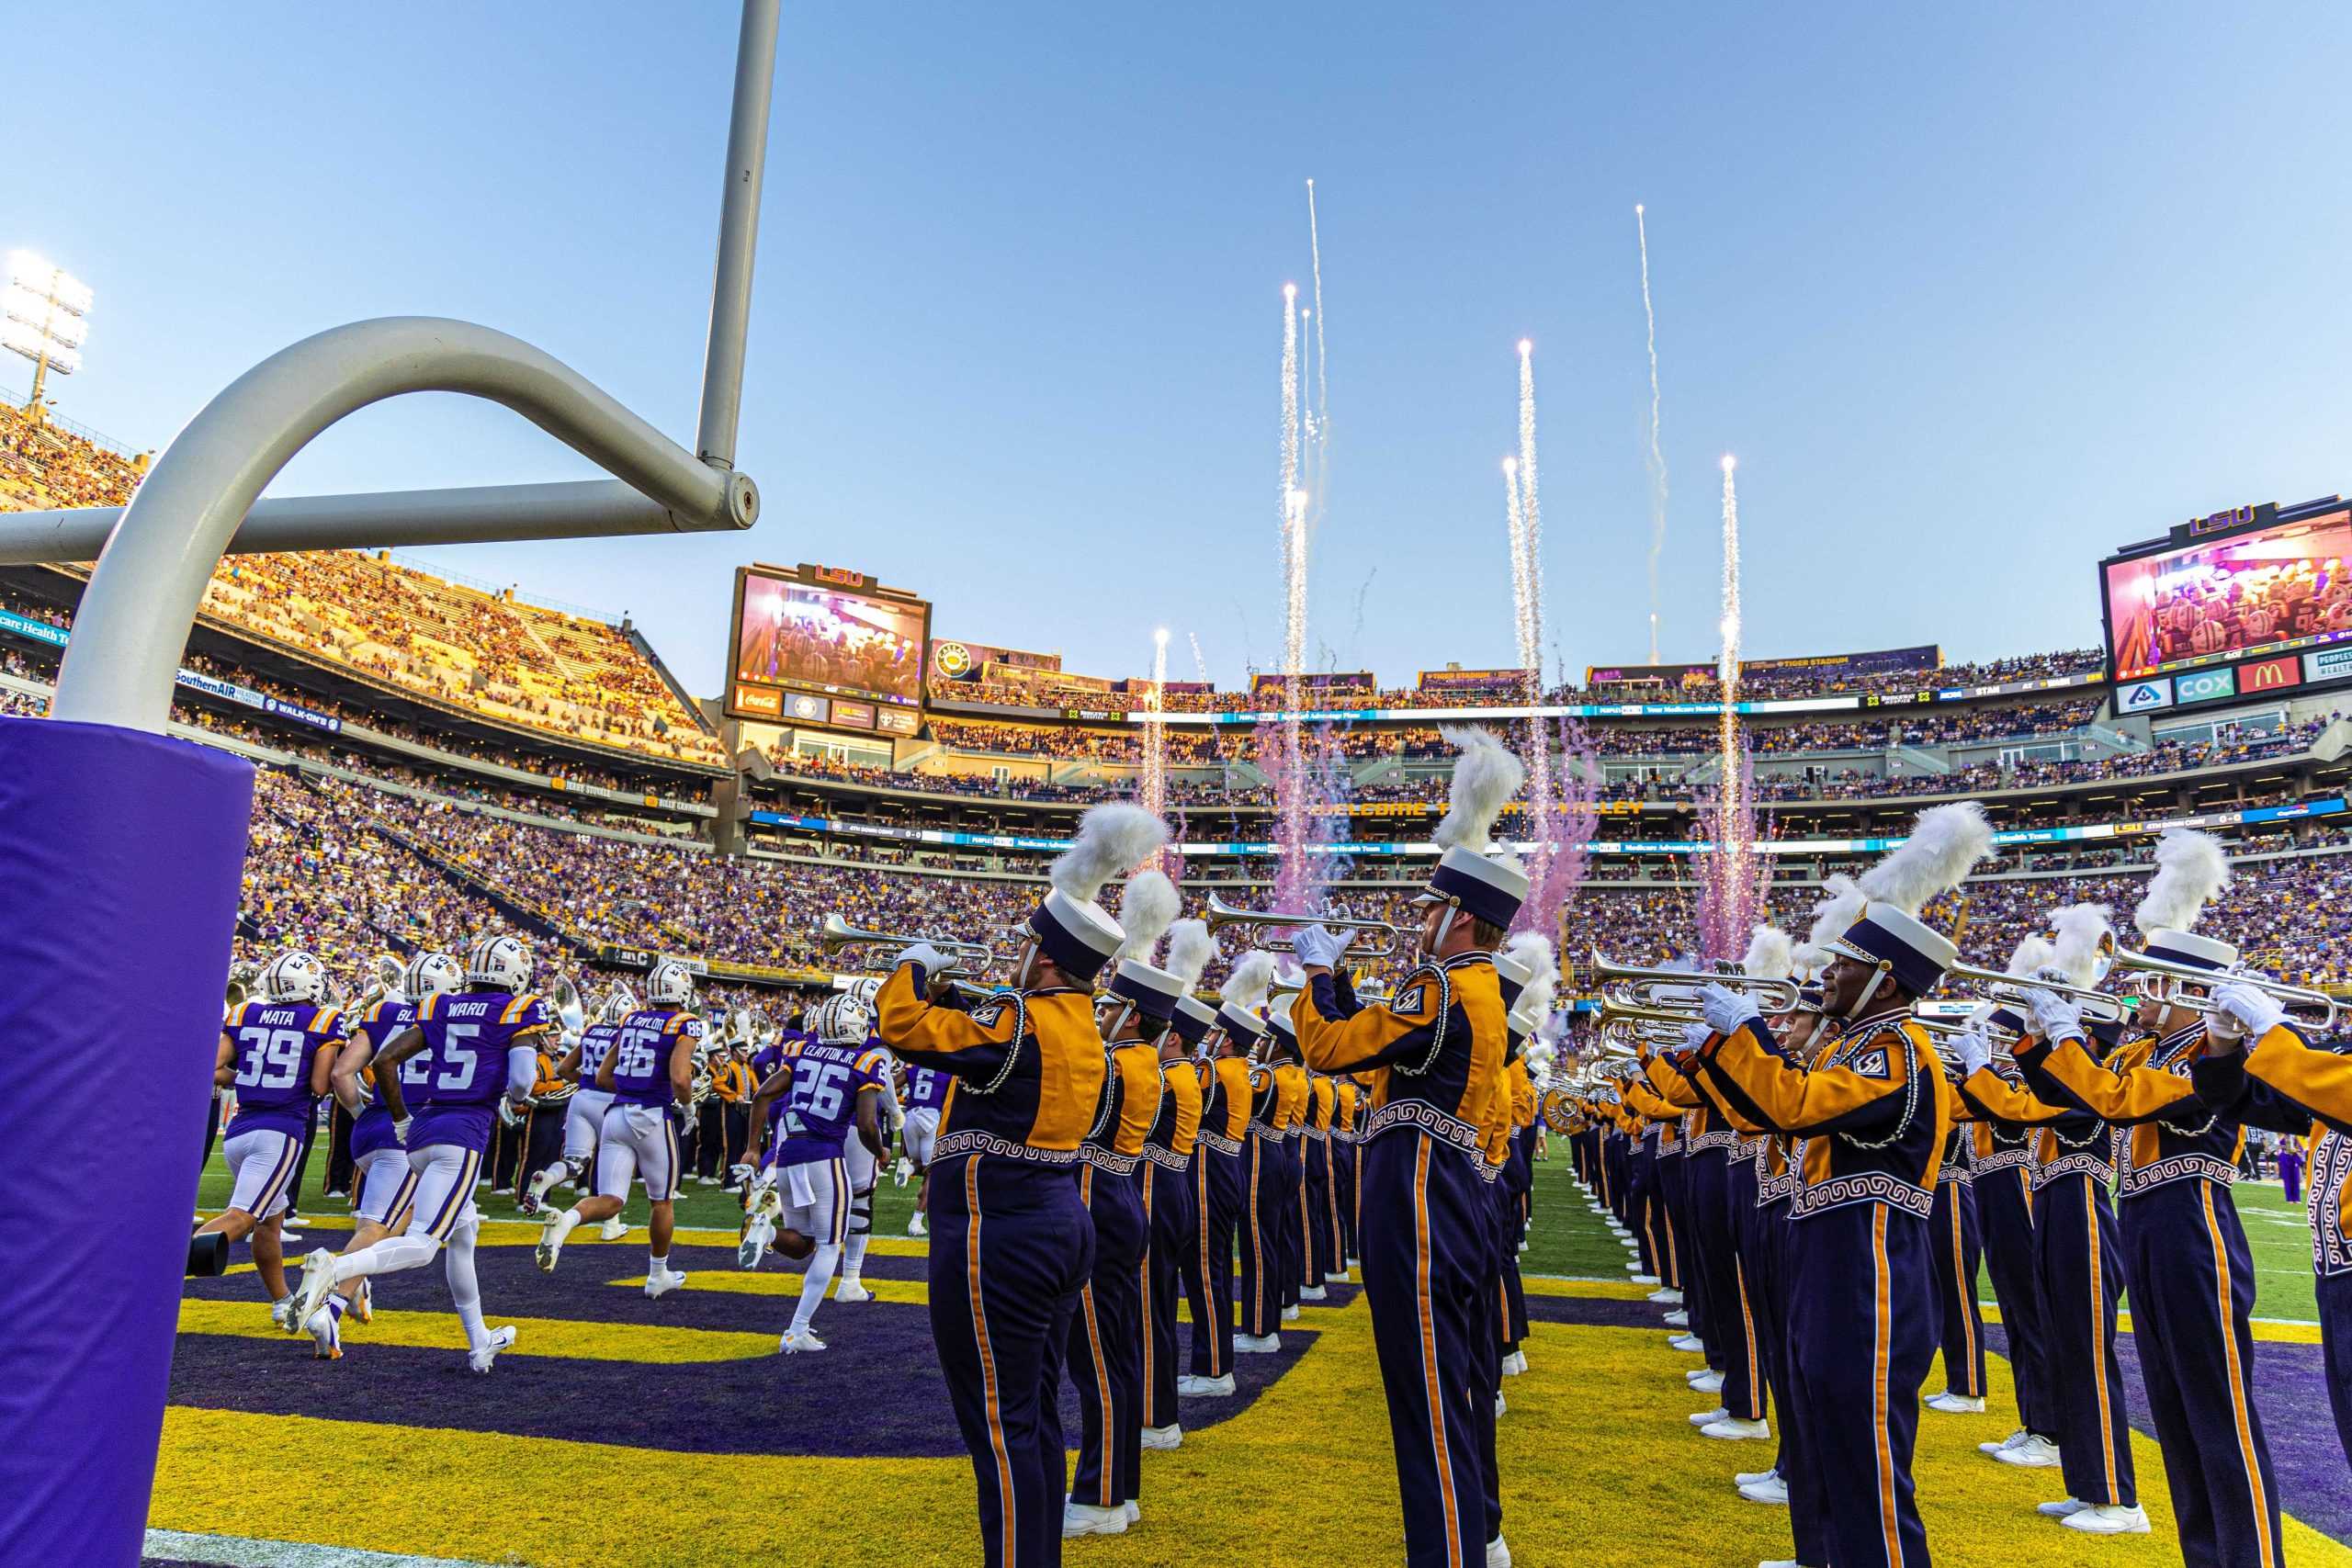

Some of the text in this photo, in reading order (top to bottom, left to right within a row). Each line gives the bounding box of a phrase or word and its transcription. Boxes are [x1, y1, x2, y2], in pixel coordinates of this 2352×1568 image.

[2188, 503, 2256, 536] LSU
[814, 564, 864, 587] LSU
[23, 623, 58, 642] Health
[1783, 659, 1809, 667] TIGER
[1810, 656, 1849, 666] STADIUM
[2178, 675, 2231, 697] COX
[2028, 832, 2052, 840] Team
[2115, 822, 2143, 834] LSU
[1017, 840, 1046, 848] Medicare
[689, 962, 706, 974] BELL
[447, 1001, 489, 1019] WARD
[1396, 991, 1419, 1010] LSU
[258, 1010, 296, 1025] MATA
[336, 1017, 348, 1037] 3
[635, 1016, 666, 1031] TAYLOR
[686, 1021, 703, 1037] 86
[234, 1026, 305, 1089] 39
[436, 1023, 481, 1089] 5
[582, 1037, 613, 1076] 69
[614, 1028, 662, 1077] 86
[803, 1044, 855, 1066] CLAYTON JR.
[1856, 1055, 1883, 1073] LSU
[789, 1058, 850, 1122] 26
[913, 1067, 935, 1100] 6
